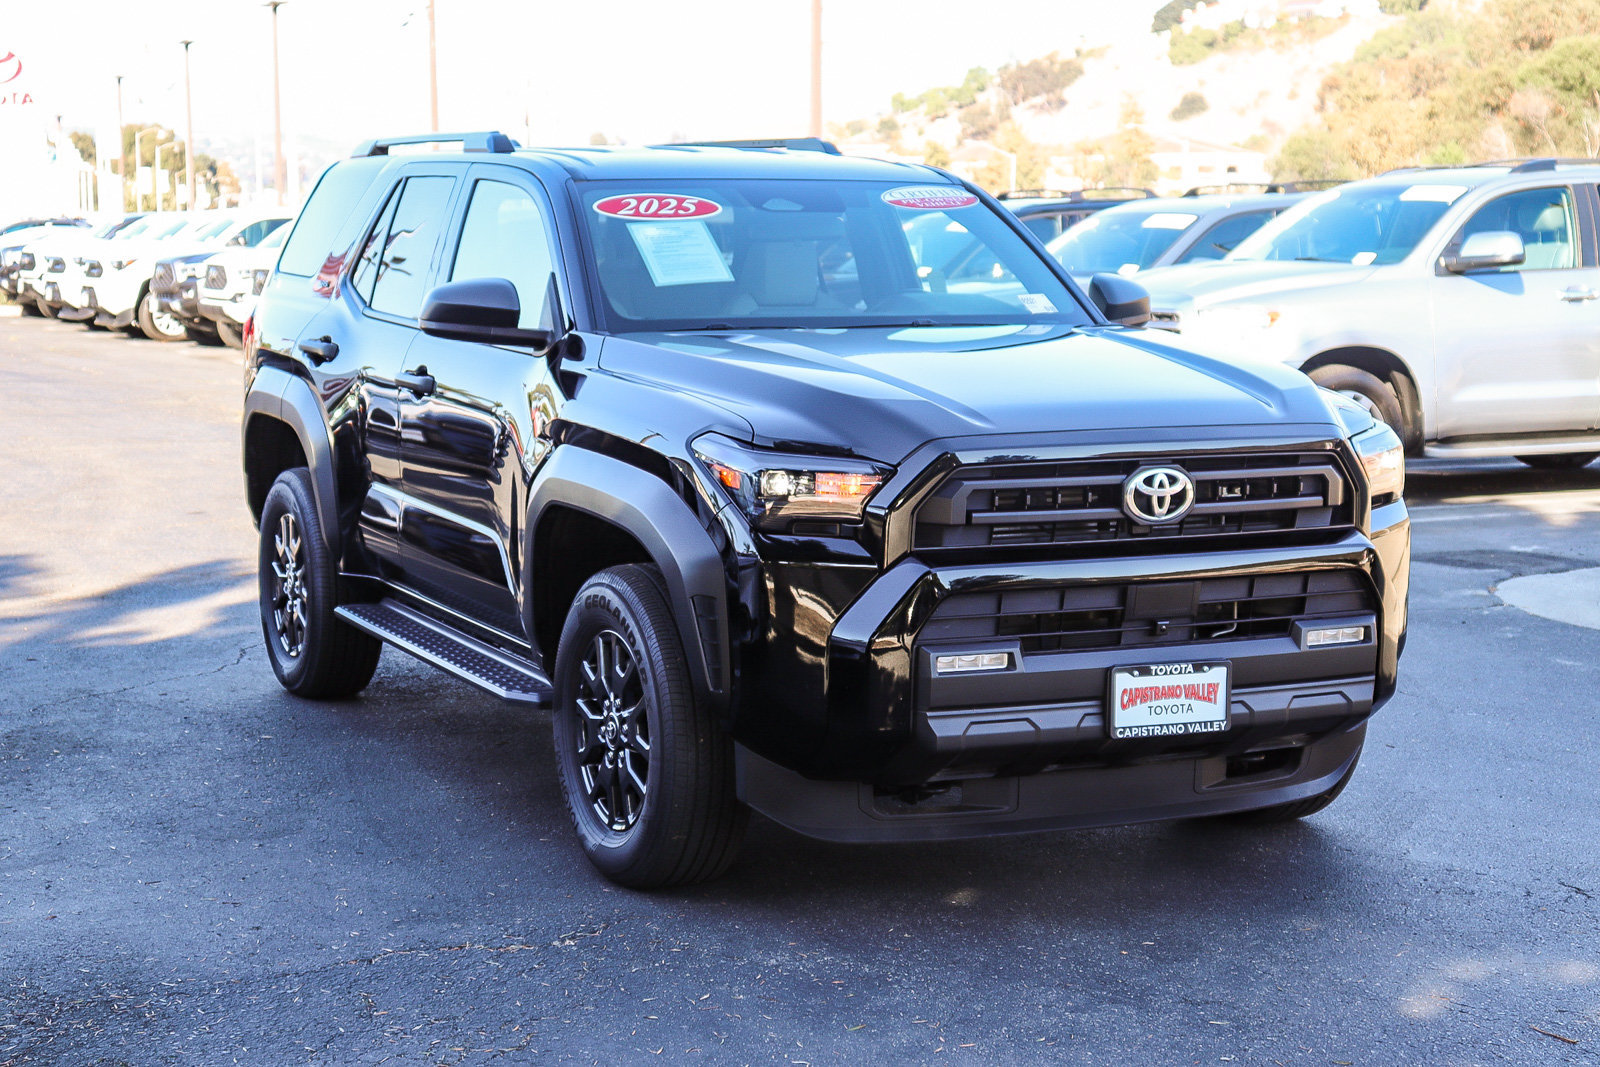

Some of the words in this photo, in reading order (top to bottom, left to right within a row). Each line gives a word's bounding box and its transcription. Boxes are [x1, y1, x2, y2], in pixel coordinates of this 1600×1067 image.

[617, 198, 699, 215] 2025
[584, 594, 649, 685] GEOLANDAR
[1150, 664, 1194, 675] TOYOTA
[1120, 685, 1184, 711] CAPISTRANO
[1183, 682, 1220, 705] VALLEY
[1148, 703, 1194, 716] TOYOTA
[1116, 723, 1185, 738] CAPISTRANO
[1187, 721, 1227, 732] VALLEY
